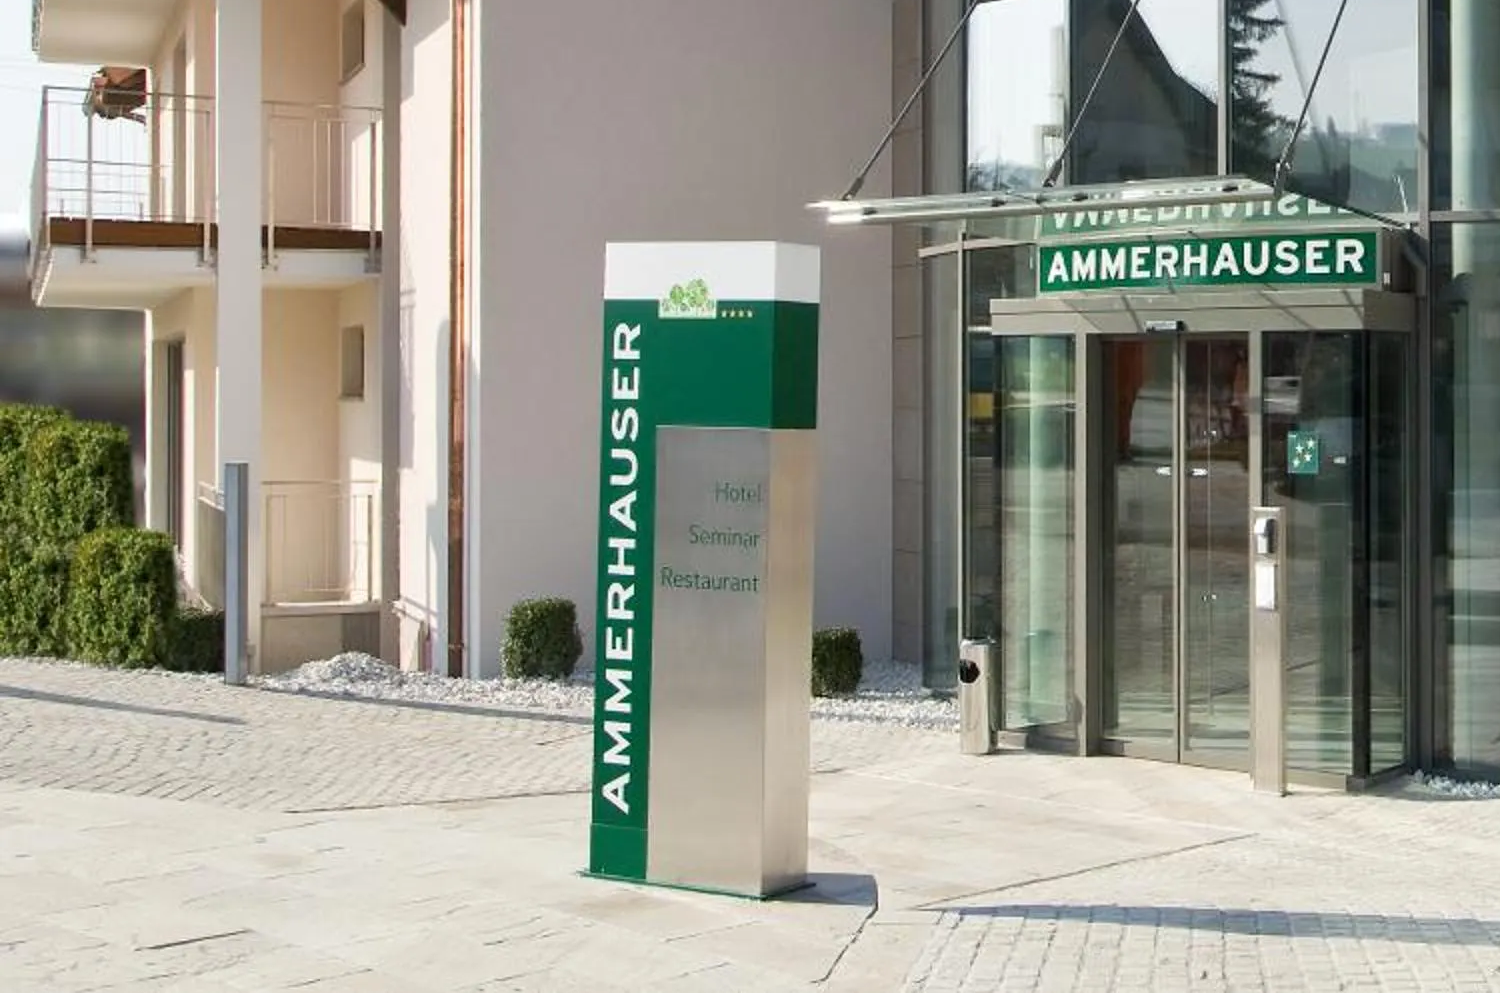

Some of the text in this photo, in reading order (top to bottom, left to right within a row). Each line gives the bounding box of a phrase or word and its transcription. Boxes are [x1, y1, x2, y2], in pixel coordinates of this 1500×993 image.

[1047, 238, 1365, 284] AMMERHAUSER
[715, 481, 763, 503] Hotel
[688, 524, 760, 547] Seminar
[602, 322, 641, 815] AMMERHAUSER
[660, 566, 760, 592] Restaurant
